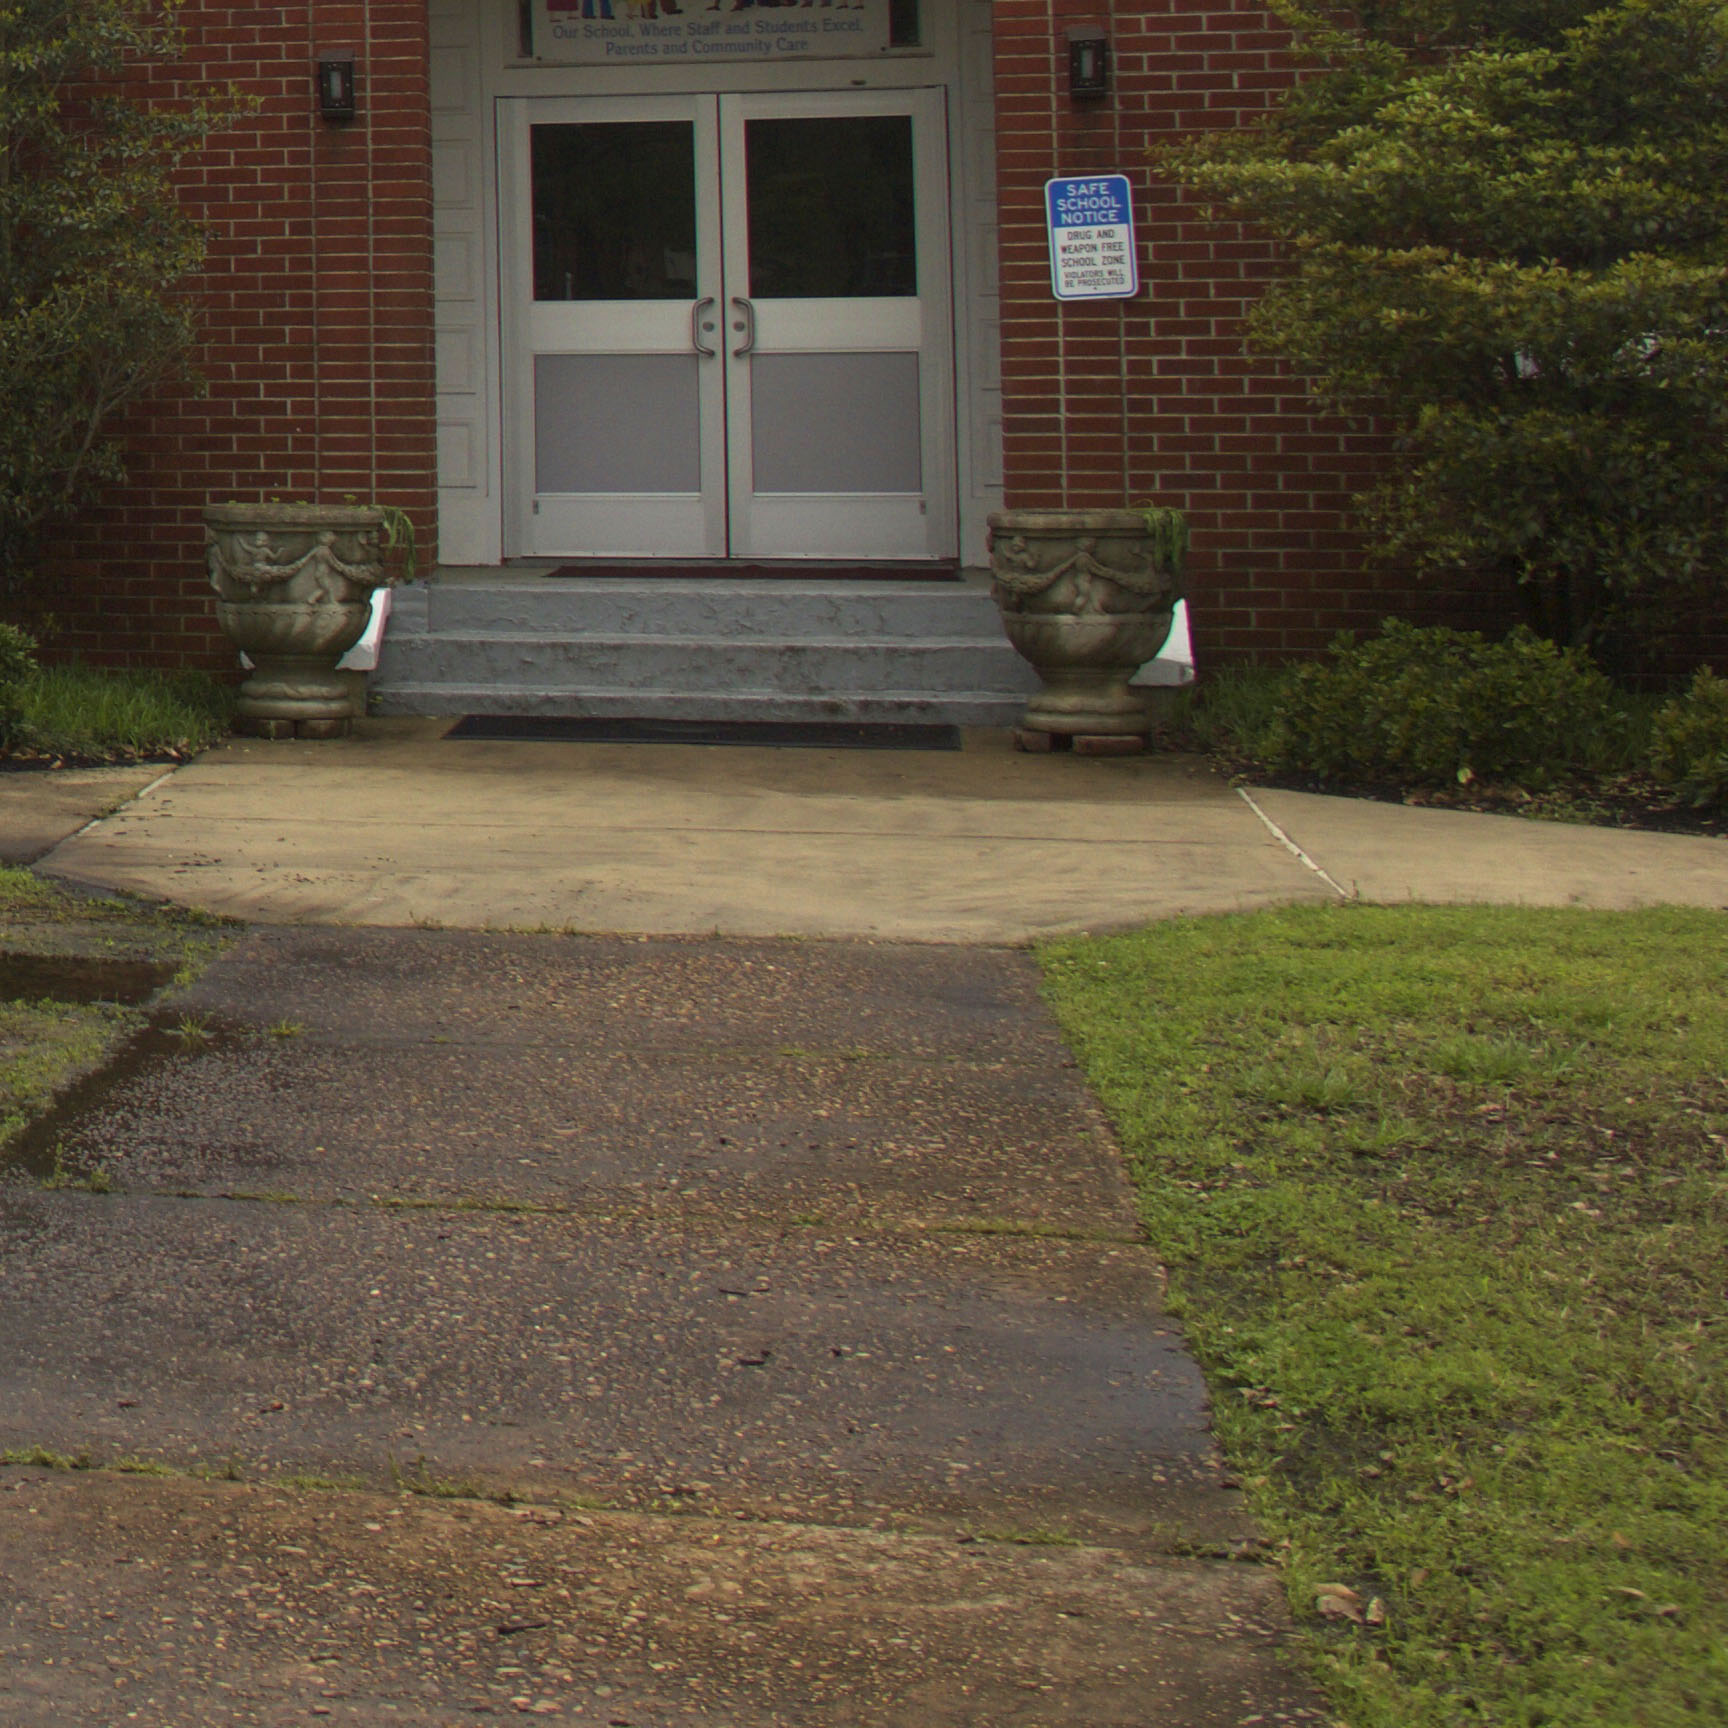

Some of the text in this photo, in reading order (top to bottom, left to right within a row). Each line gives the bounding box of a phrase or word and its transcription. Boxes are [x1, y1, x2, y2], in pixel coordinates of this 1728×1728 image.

[552, 25, 578, 39] Our
[640, 23, 681, 37] Where
[687, 21, 720, 35] Staff
[725, 21, 750, 34] and
[755, 19, 817, 33] Students
[606, 37, 808, 55] Parents and Community Care
[1066, 182, 1110, 197] SAFE
[1056, 196, 1121, 211] SCHOOL
[1060, 210, 1119, 225] NOTICE
[1067, 229, 1115, 241] DRUG AND
[1061, 241, 1124, 254] WEAPON FREE
[1062, 255, 1125, 268] SCHOOL ZONE
